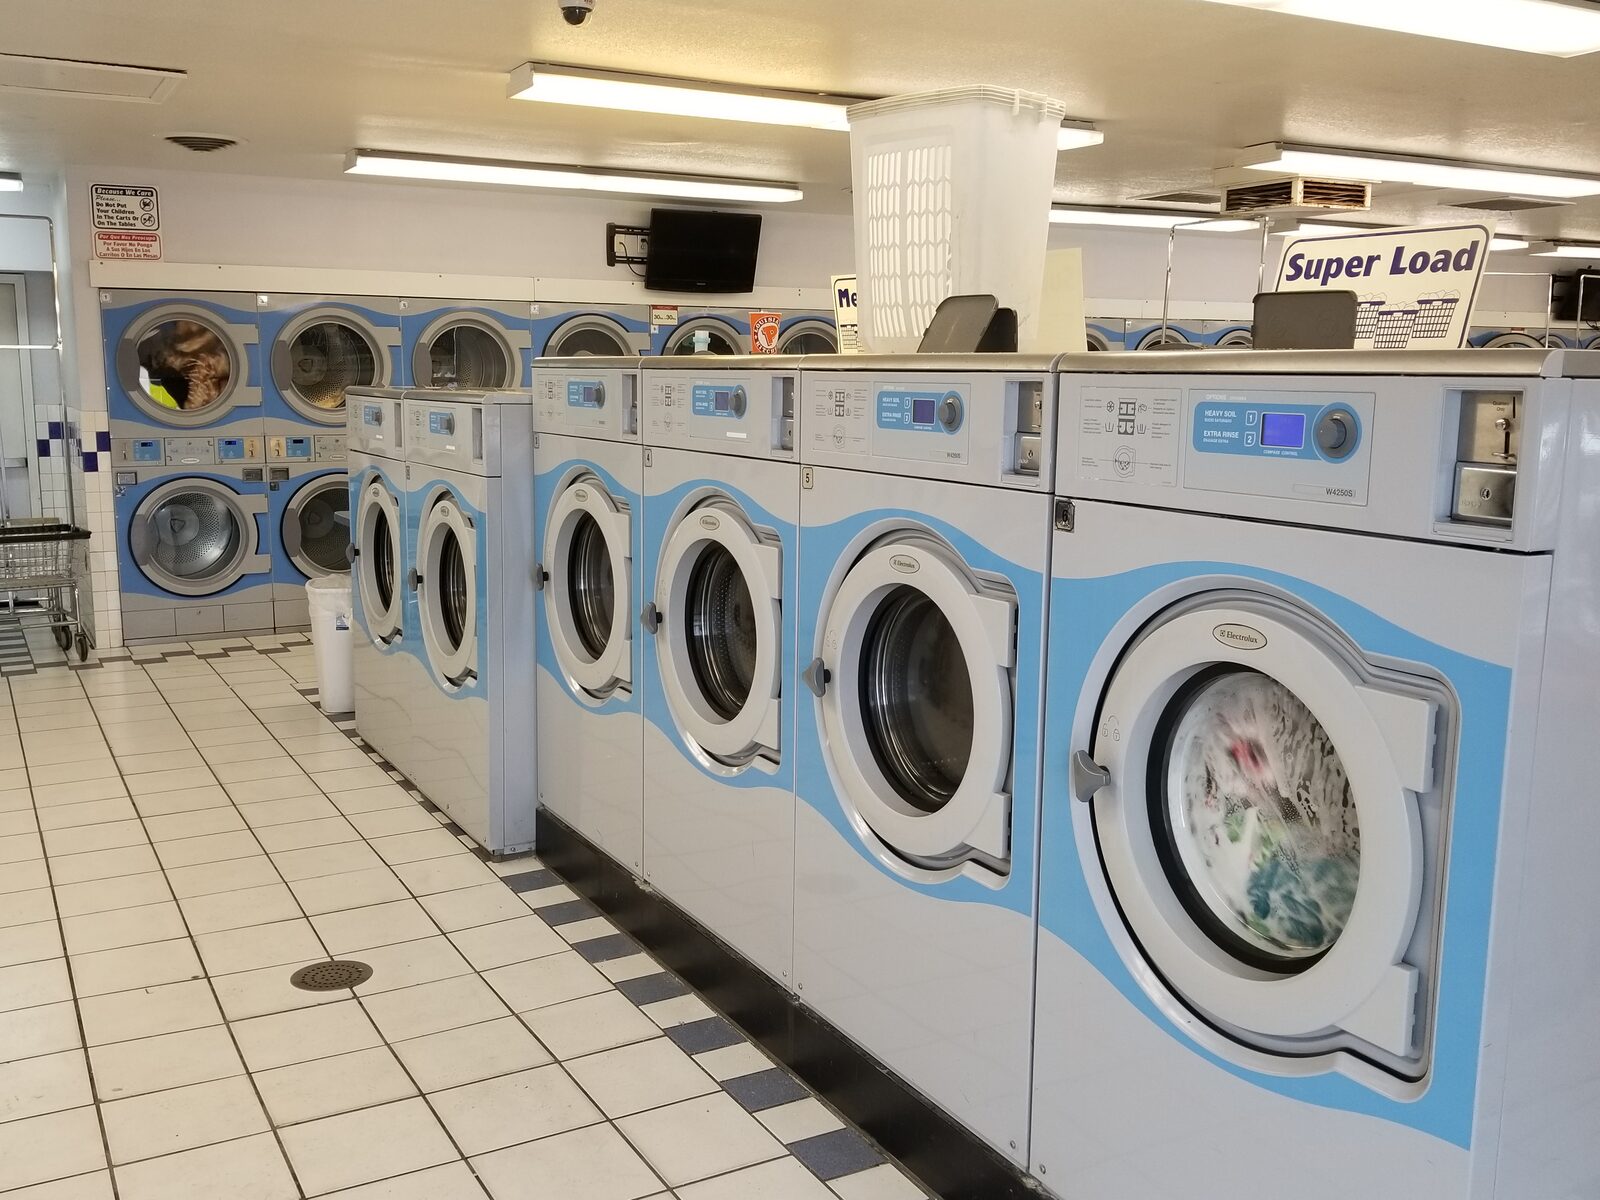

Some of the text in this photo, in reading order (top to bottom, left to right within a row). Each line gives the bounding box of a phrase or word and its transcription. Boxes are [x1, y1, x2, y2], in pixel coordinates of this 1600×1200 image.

[1286, 240, 1480, 286] Super Load
[838, 288, 857, 308] Me
[754, 317, 779, 332] LOUISIA
[806, 473, 810, 483] 5
[1325, 488, 1353, 498] W4250S
[1062, 510, 1068, 522] 6
[1226, 630, 1258, 644] Electrolux
